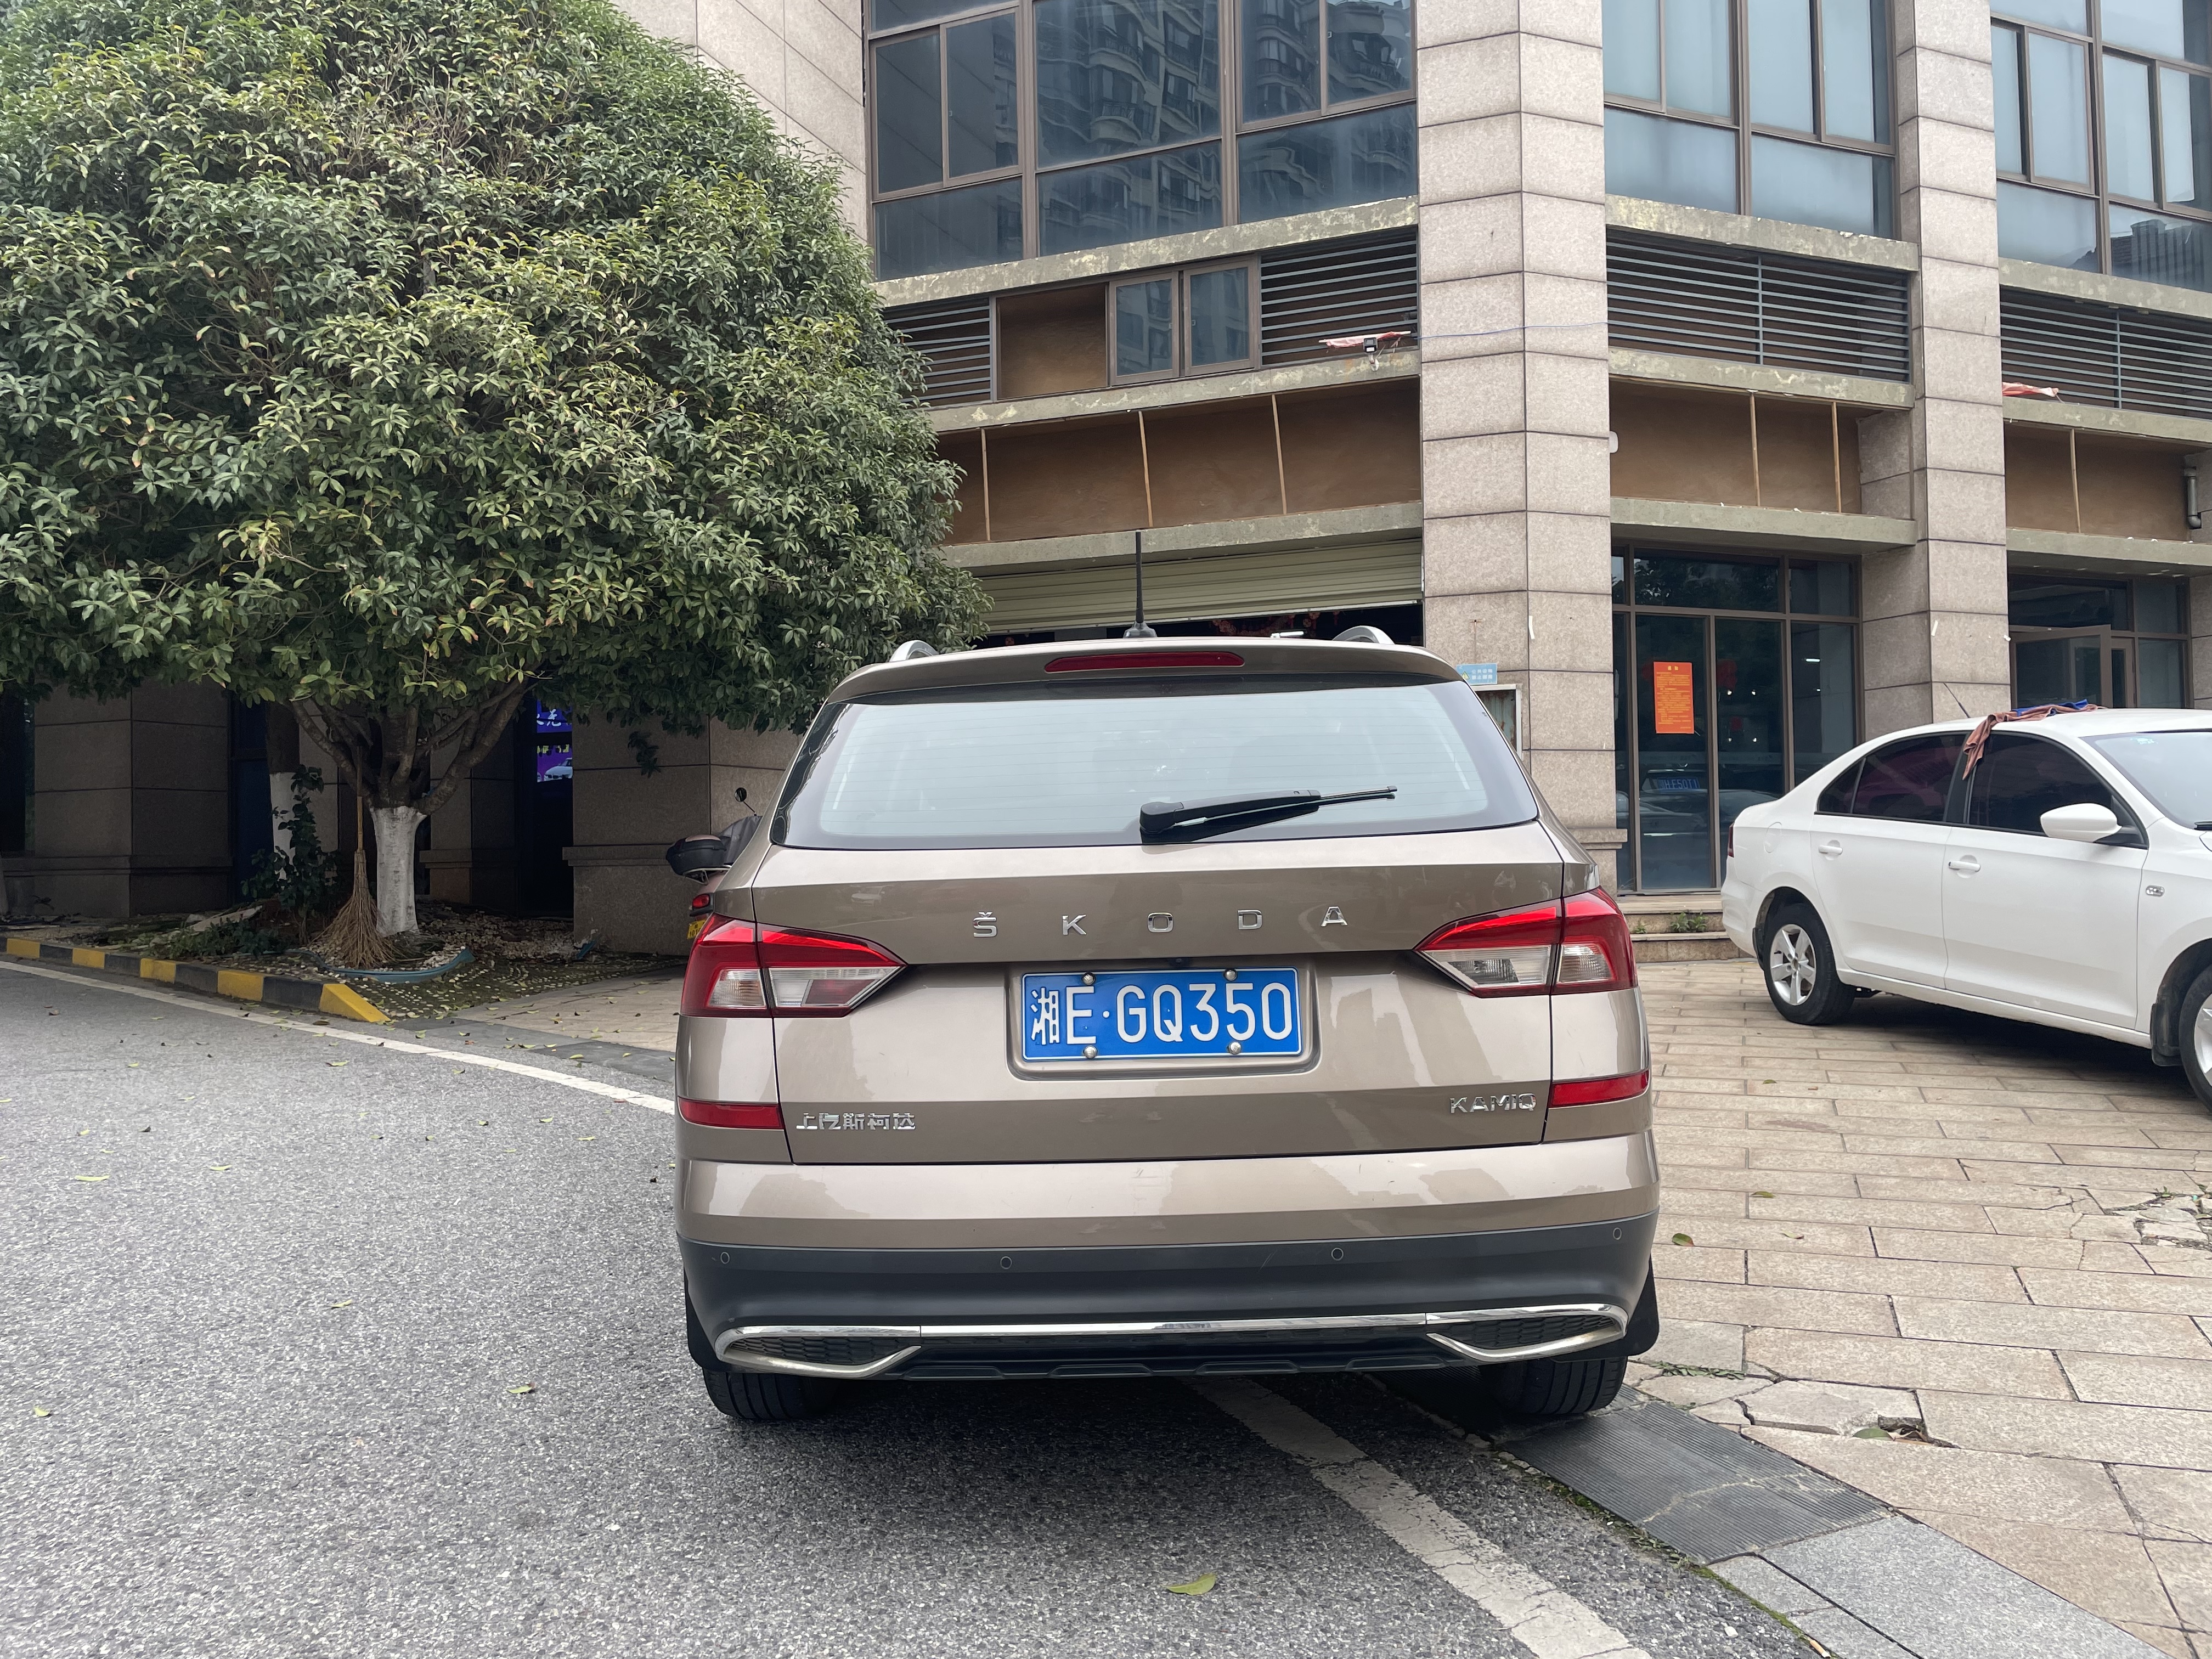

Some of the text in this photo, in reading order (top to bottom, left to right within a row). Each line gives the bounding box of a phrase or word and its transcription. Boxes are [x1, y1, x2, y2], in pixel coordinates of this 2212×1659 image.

[973, 905, 1348, 938] ŠKODA
[1031, 982, 1293, 1045] 湘E·GQ350
[1449, 1093, 1537, 1114] KAMIQ
[795, 1113, 916, 1130] 上汽斯柯达
